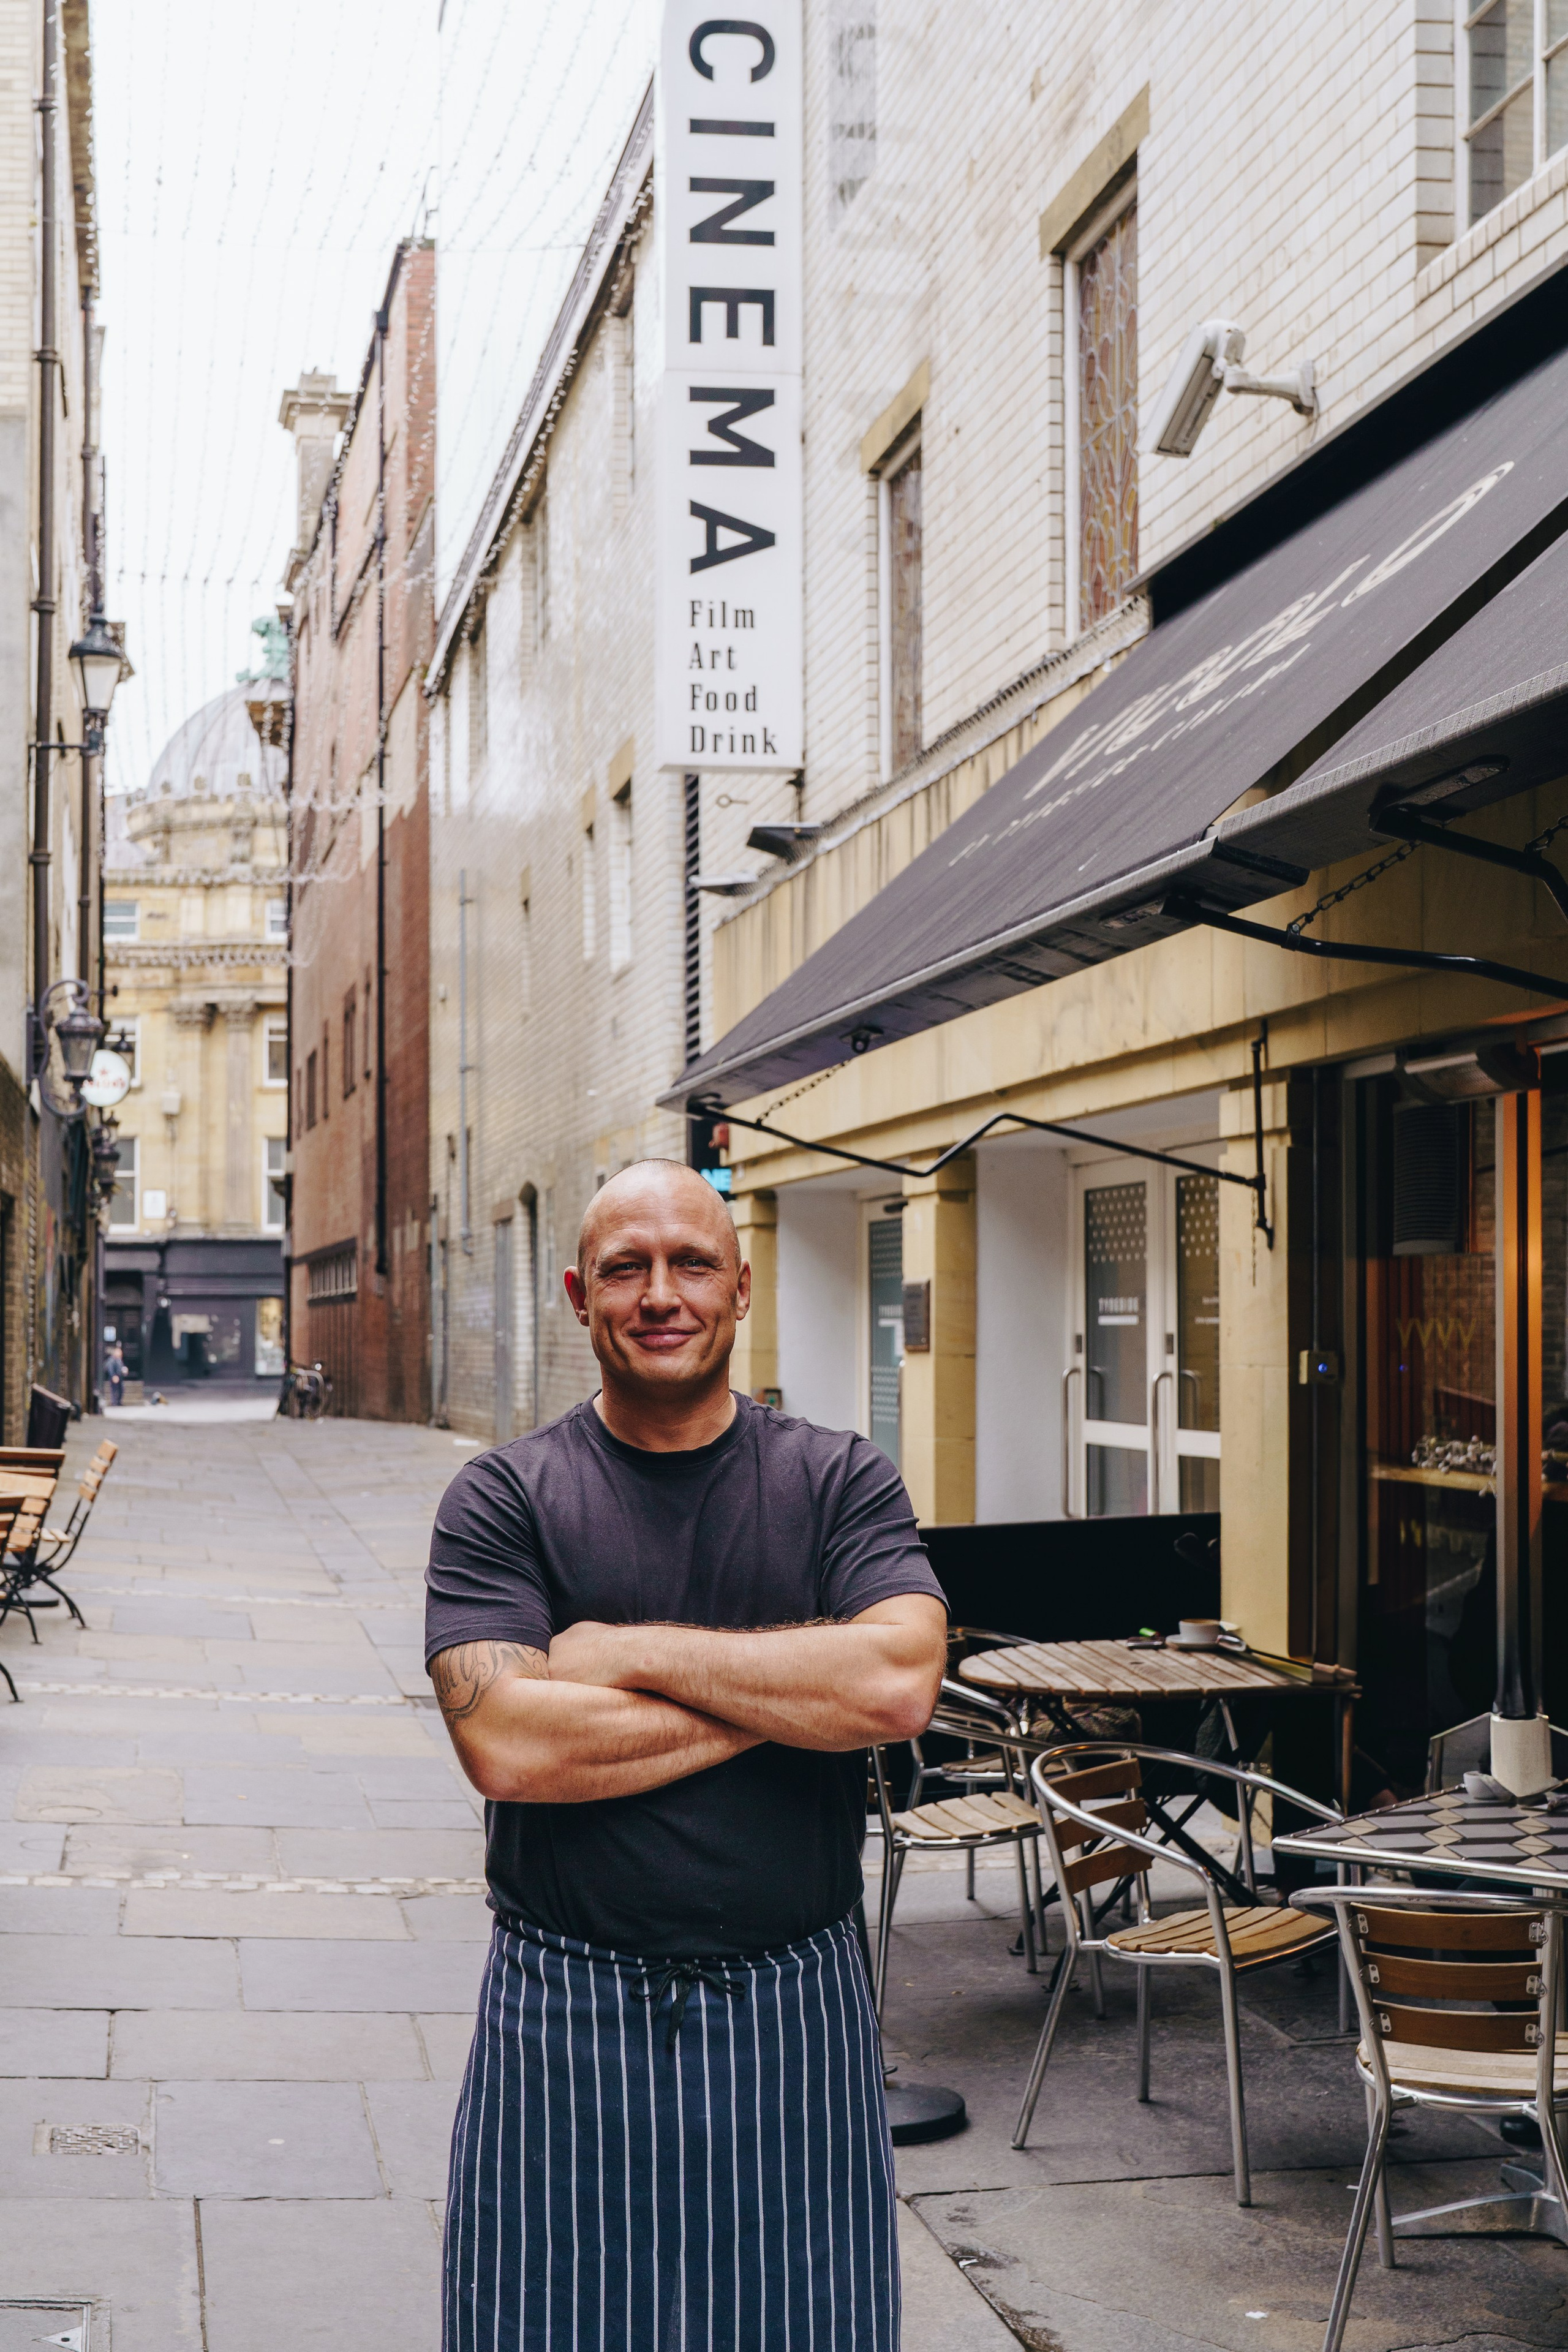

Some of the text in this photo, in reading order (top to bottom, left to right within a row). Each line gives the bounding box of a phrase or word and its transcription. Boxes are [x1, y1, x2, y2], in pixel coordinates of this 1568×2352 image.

[688, 19, 776, 574] CINEMA
[690, 600, 755, 629] Film
[689, 642, 737, 669] Art
[690, 684, 758, 712] Food
[690, 725, 777, 755] Drink
